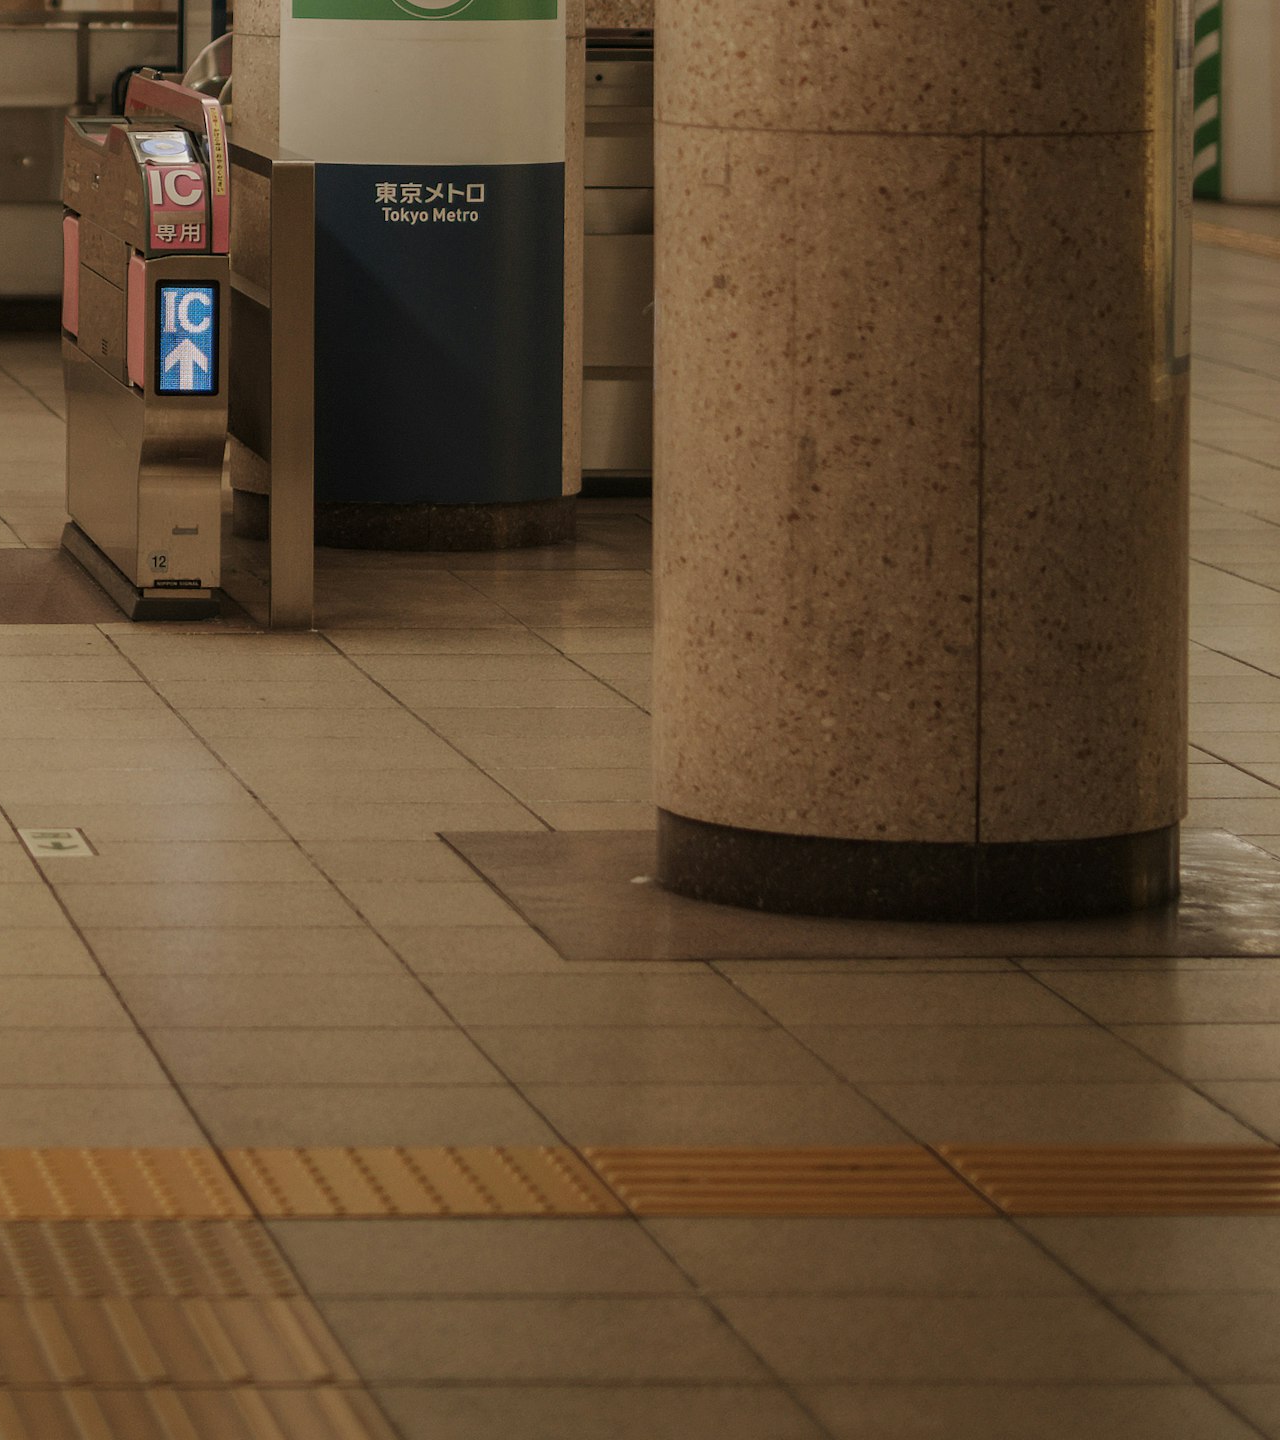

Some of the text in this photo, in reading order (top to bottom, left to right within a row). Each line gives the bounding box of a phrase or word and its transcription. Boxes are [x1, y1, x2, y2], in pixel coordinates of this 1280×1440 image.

[149, 169, 203, 206] IC
[375, 182, 485, 204] 東京メトロ
[381, 207, 479, 226] Tokyo Metro
[162, 291, 211, 334] IC
[151, 555, 167, 568] 12
